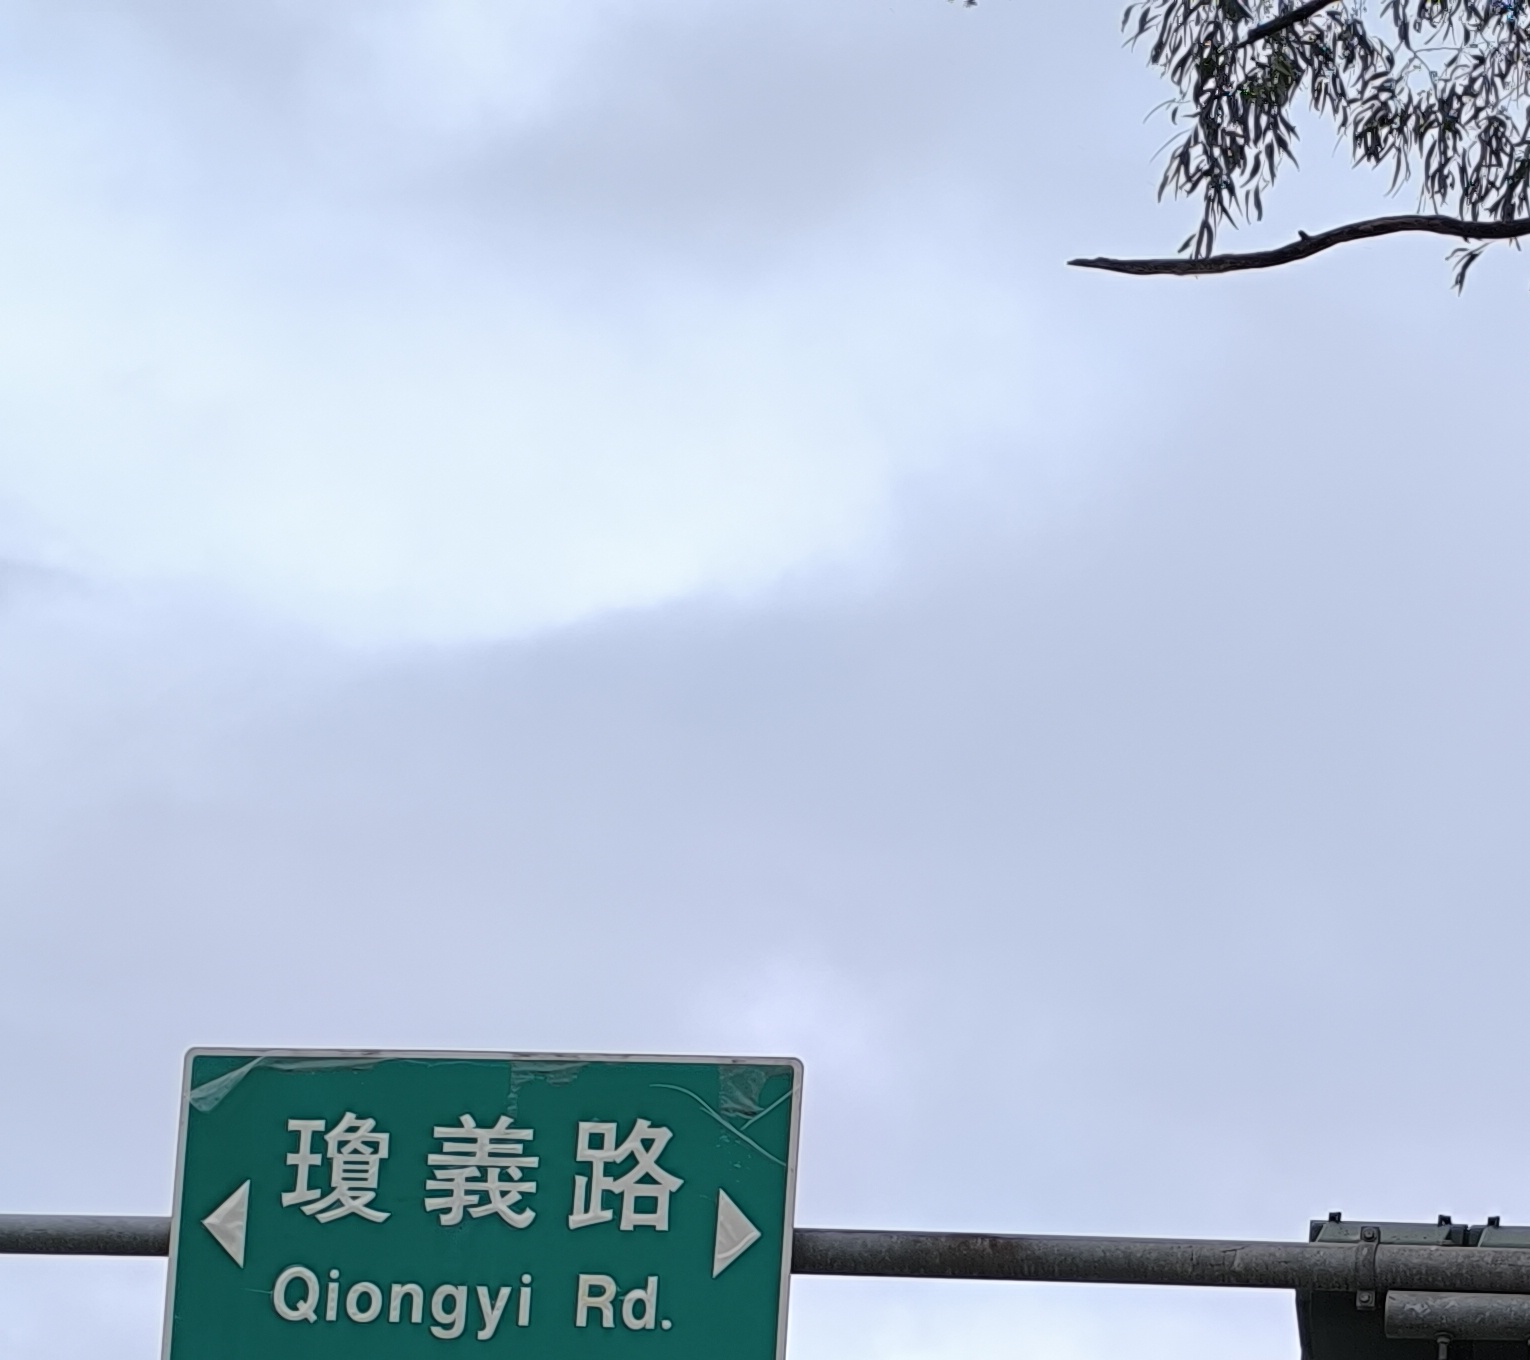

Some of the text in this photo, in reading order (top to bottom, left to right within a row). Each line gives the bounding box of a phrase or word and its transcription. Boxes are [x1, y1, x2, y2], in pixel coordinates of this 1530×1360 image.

[281, 1111, 684, 1232] 瓊義路
[271, 1265, 672, 1340] Qiongyi Rd.
